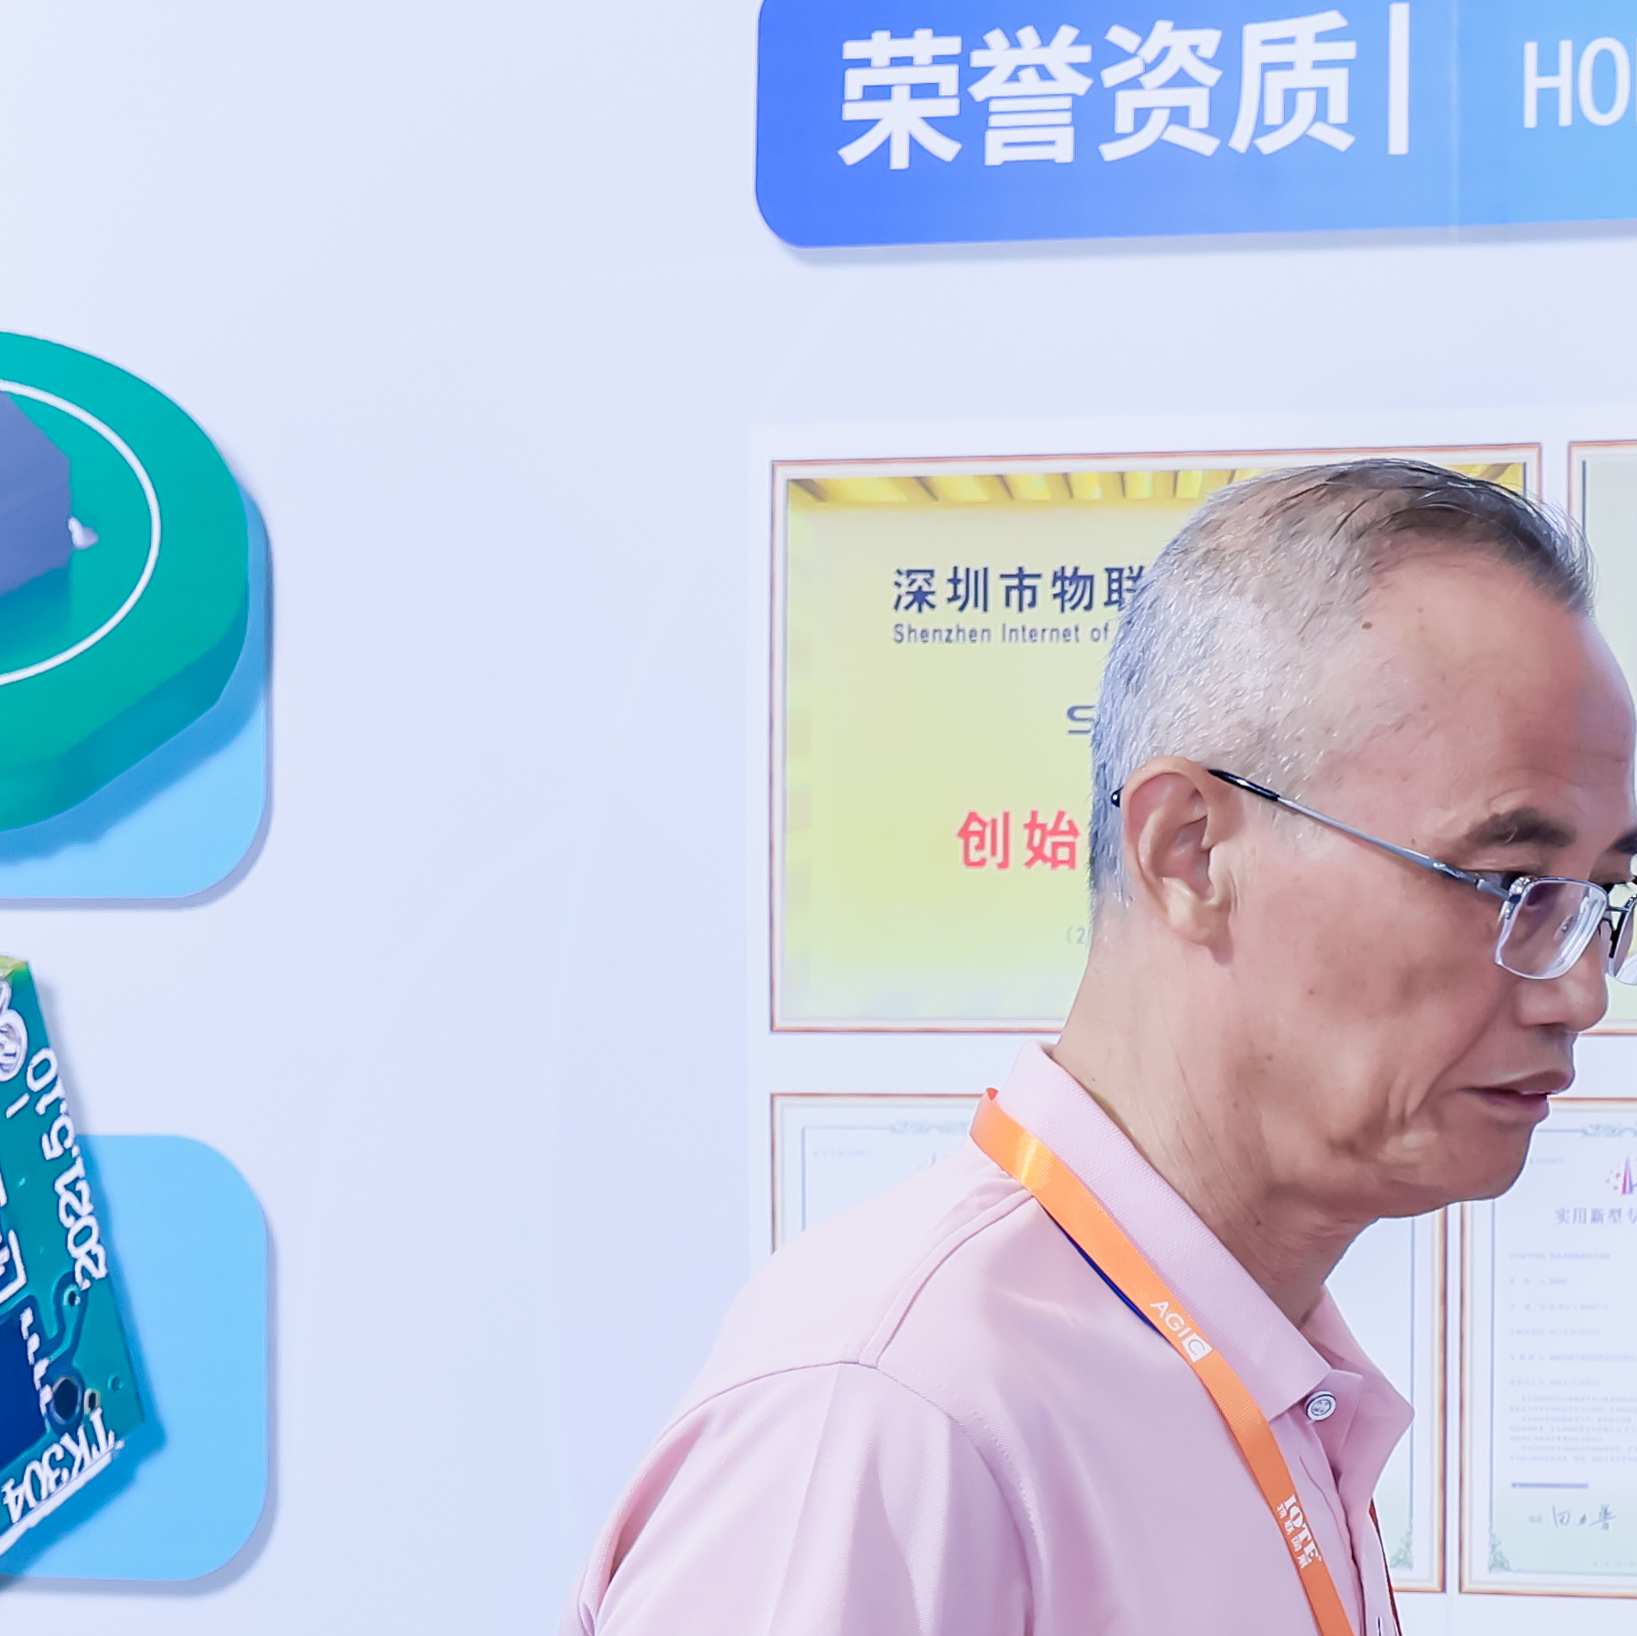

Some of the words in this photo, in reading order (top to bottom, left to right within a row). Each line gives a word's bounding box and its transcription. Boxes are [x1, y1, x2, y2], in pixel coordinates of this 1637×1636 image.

[838, 9, 1358, 169] 荣誉资质
[893, 623, 991, 645] Shenzhen
[1001, 622, 1080, 643] Internet
[1090, 622, 1110, 643] of
[956, 809, 1080, 870] 创始
[1149, 1300, 1214, 1362] AGIC
[1281, 1493, 1321, 1565] IOTE
